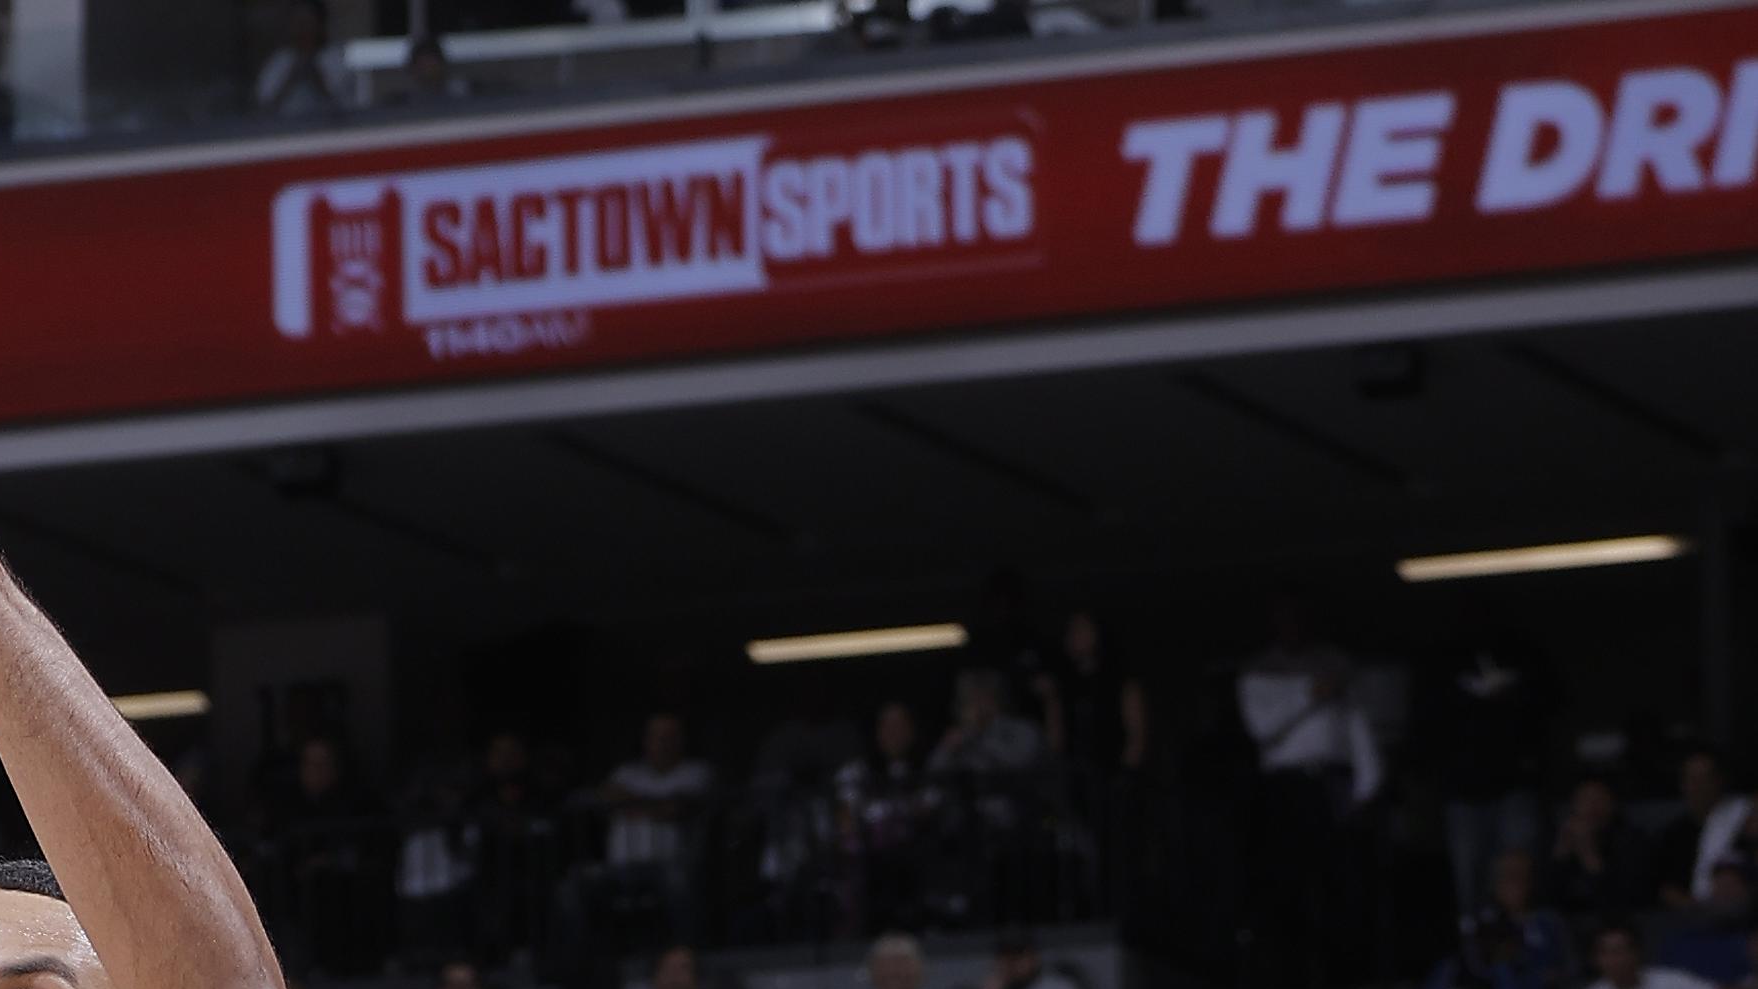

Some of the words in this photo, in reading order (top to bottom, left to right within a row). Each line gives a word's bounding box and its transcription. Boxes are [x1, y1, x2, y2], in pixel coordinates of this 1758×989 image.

[422, 168, 748, 291] SACTOWN
[761, 136, 1034, 262] SPORTS
[1122, 92, 1454, 245] THE
[1477, 58, 1758, 214] DRI
